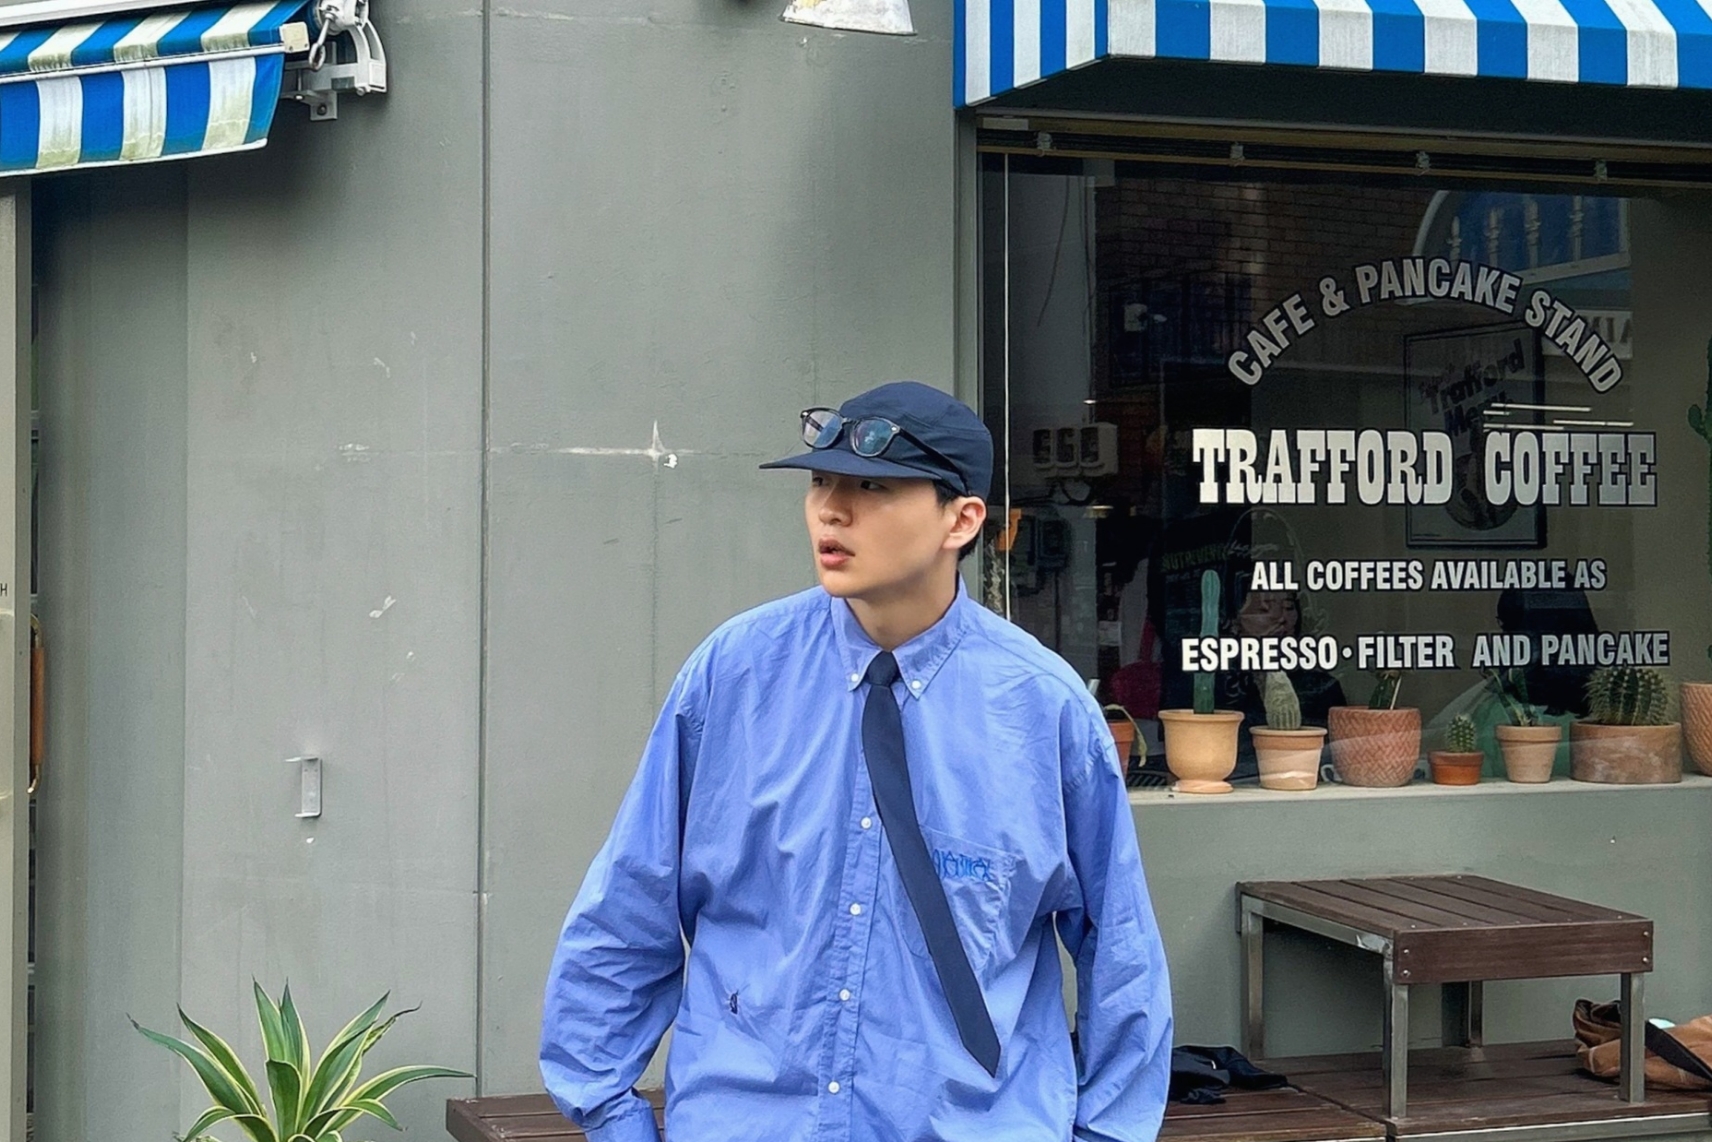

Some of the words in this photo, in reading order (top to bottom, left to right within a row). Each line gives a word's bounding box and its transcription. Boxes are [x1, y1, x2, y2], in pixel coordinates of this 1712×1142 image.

[1228, 293, 1315, 386] CAFE
[1318, 276, 1351, 317] &
[1355, 257, 1522, 314] PANCAKE
[1525, 291, 1622, 393] STAND
[1192, 428, 1453, 505] TRAFFORD
[1484, 431, 1657, 506] COFFEE
[1250, 561, 1299, 591] ALL
[1307, 560, 1423, 591] COFFEES
[1431, 560, 1566, 590] AVAILABLE
[1574, 560, 1607, 589] AS
[1472, 634, 1531, 667] AND
[1542, 632, 1669, 666] PANCAKE
